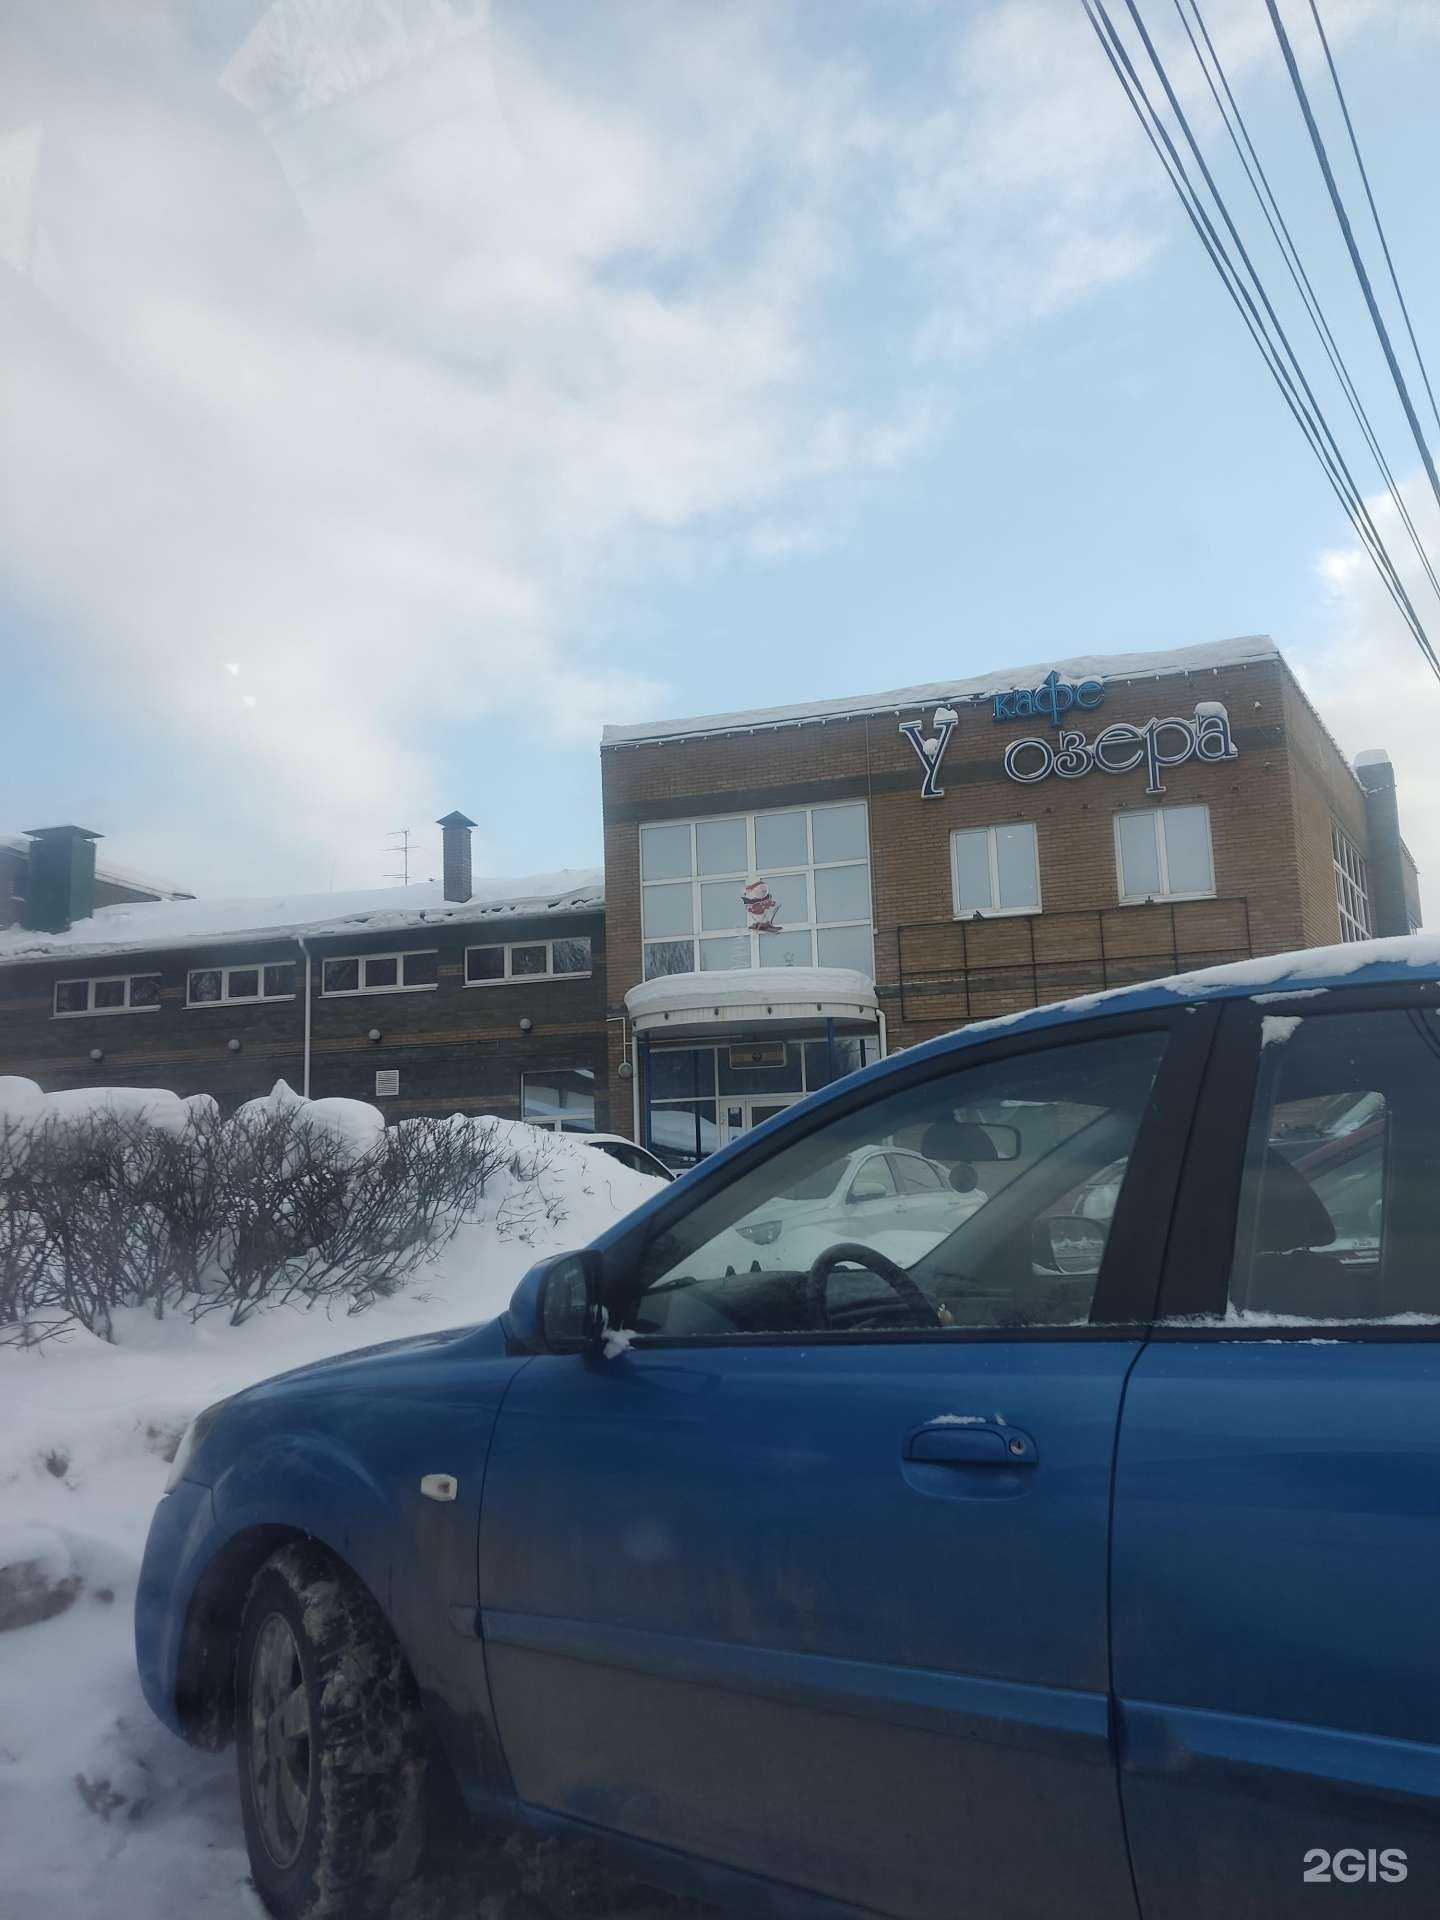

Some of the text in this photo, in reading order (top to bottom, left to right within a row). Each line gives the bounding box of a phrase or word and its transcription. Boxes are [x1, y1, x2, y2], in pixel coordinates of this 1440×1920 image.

[992, 670, 1105, 727] кафе
[898, 711, 1239, 799] У озера
